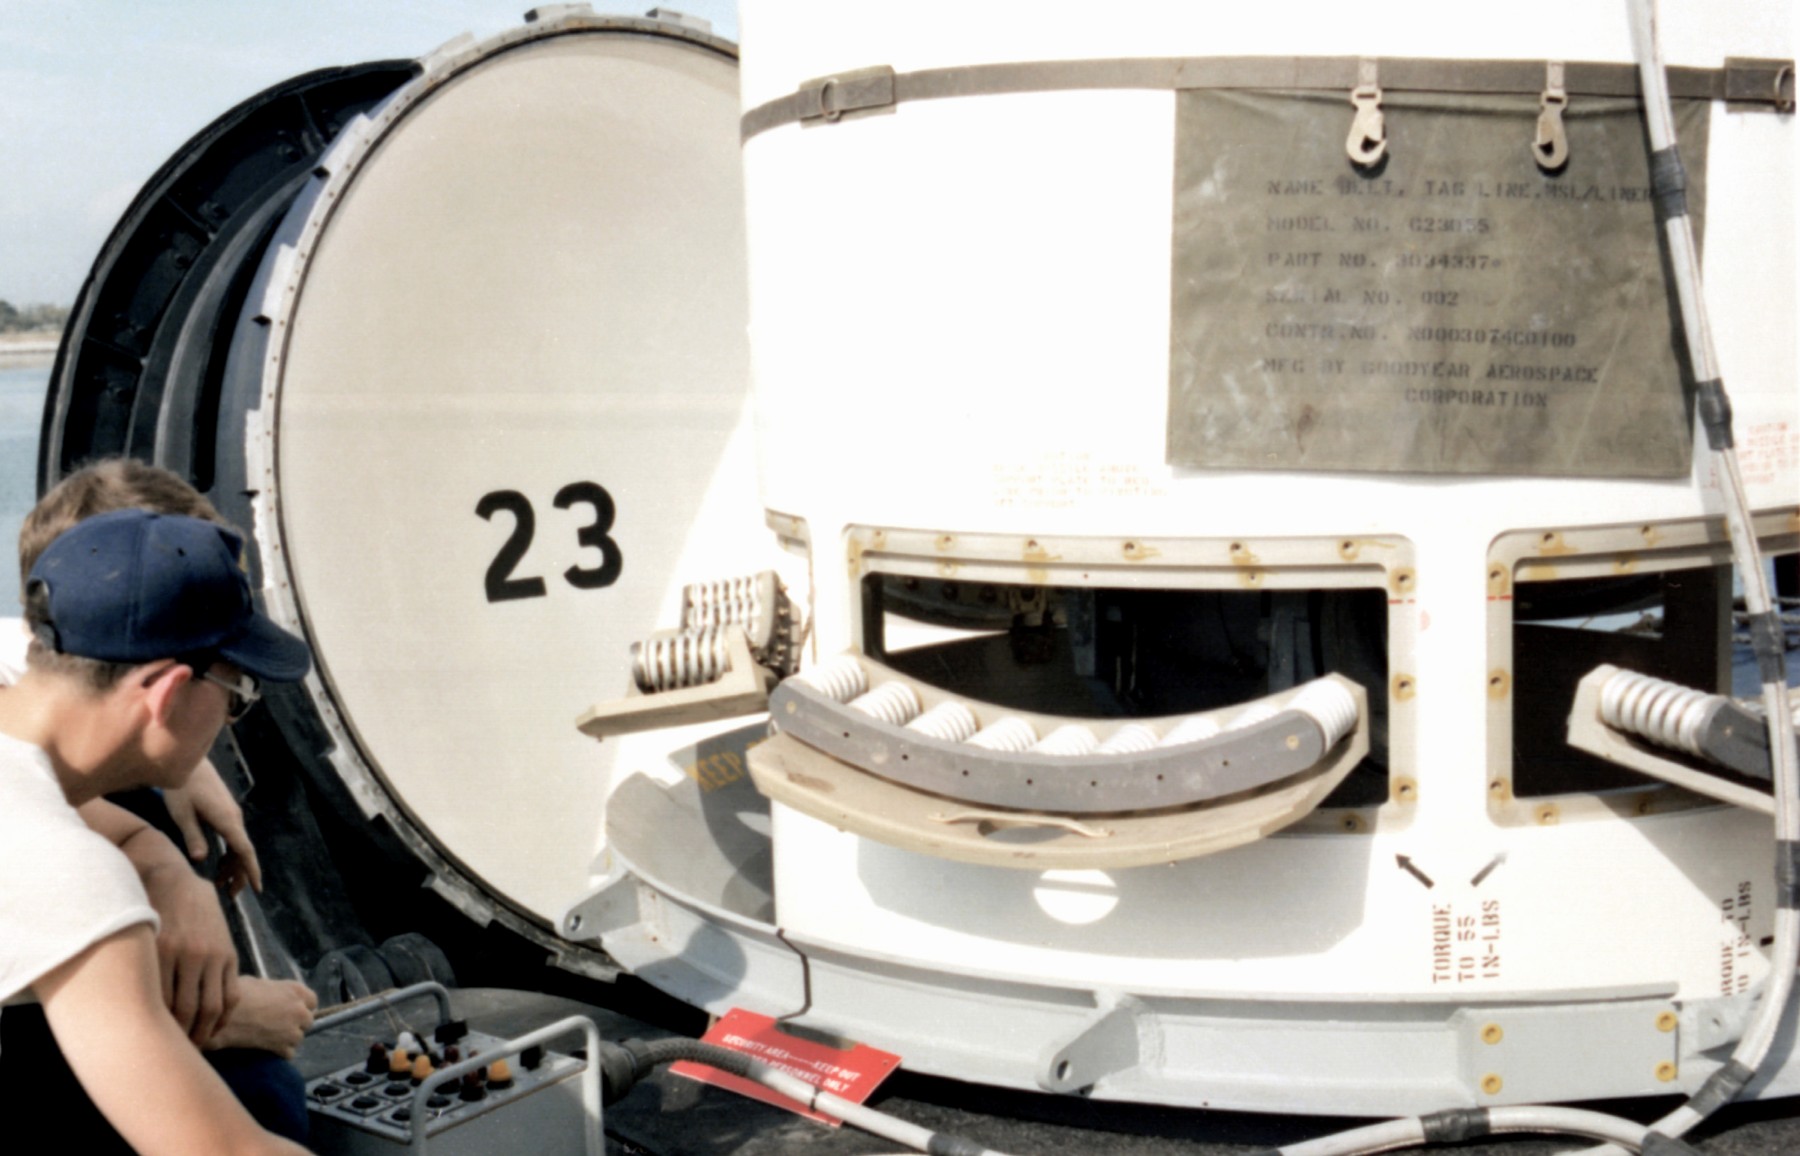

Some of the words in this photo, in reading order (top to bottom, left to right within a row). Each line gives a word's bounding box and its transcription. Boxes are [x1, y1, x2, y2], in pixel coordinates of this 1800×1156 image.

[1268, 180, 1323, 195] NAME
[1425, 180, 1465, 196] TAG
[1267, 215, 1335, 232] MODEL
[1353, 216, 1390, 232] NO.
[1268, 252, 1322, 267] PART
[1339, 252, 1376, 267] NO.
[1363, 289, 1402, 305] NO.
[1422, 290, 1459, 306] 002
[1262, 357, 1305, 374] MFG
[1321, 359, 1345, 374] BY
[1361, 360, 1470, 378] GOODYEAR
[1486, 363, 1598, 383] AEROSPACE
[1405, 387, 1548, 408] CORPORATION
[474, 480, 623, 604] 23
[1457, 916, 1475, 941] 55
[1482, 900, 1500, 977] IN-LBS
[1433, 903, 1451, 984] TORQUE
[1457, 956, 1475, 983] TO
[722, 1033, 766, 1051] SECURITY
[763, 1046, 790, 1060] AREA
[837, 1068, 861, 1083] OUT
[822, 1078, 851, 1093] ONLY
